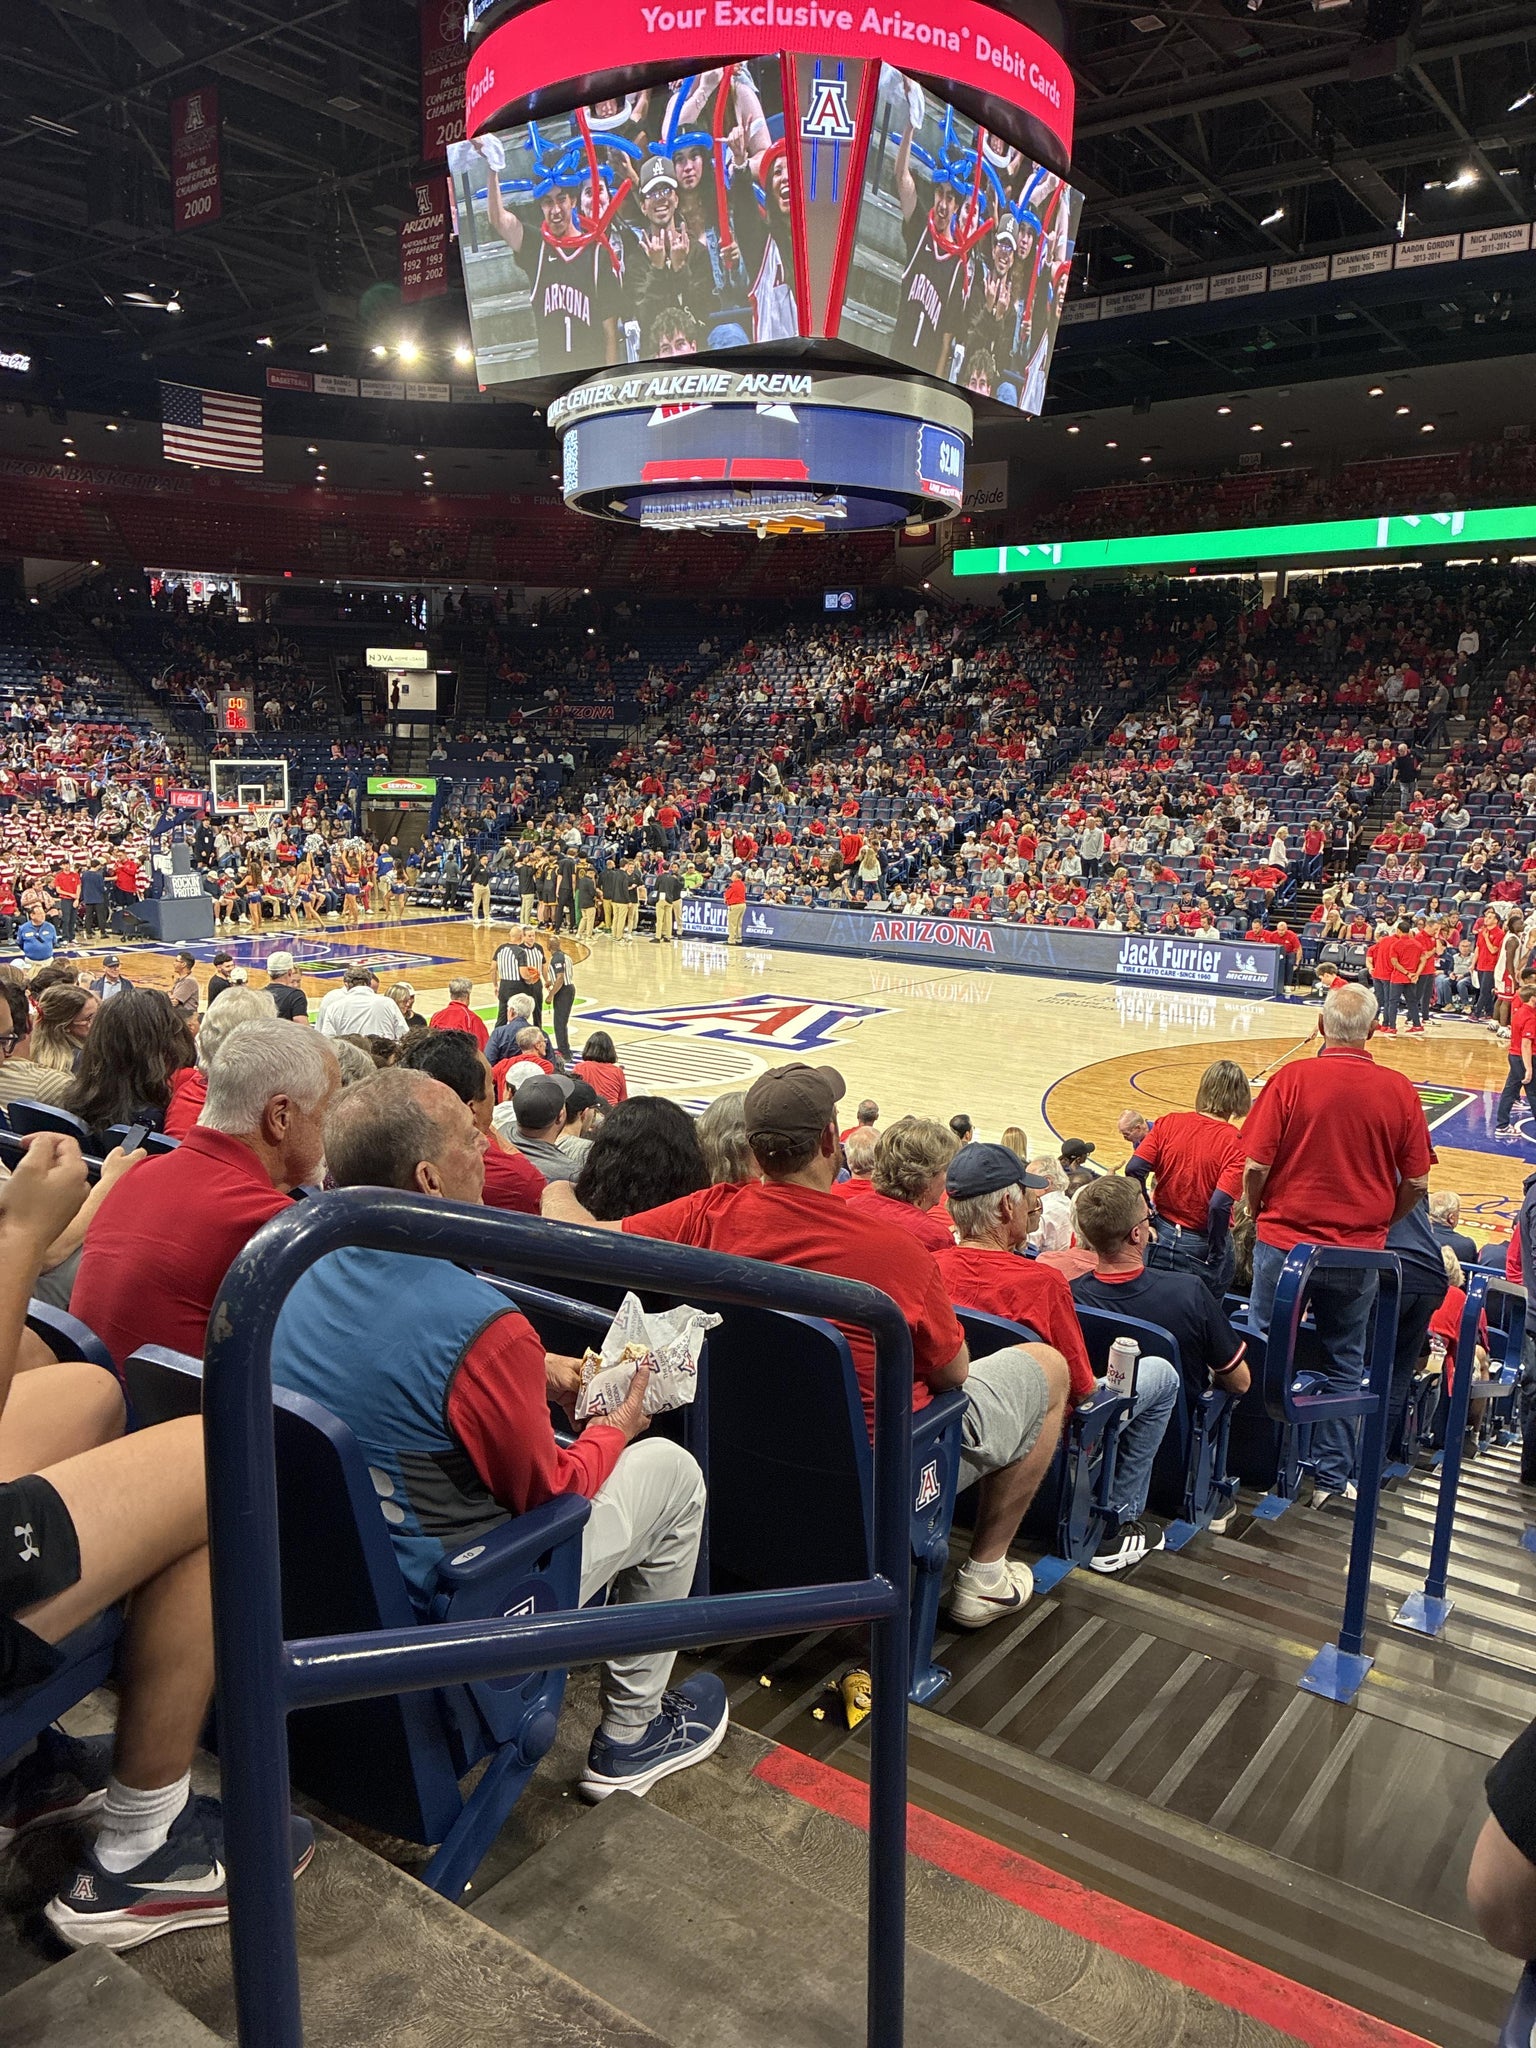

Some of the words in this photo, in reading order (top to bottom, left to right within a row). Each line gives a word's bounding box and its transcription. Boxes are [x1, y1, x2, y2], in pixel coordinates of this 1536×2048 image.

[641, 6, 706, 32] Your
[715, 0, 853, 30] Exclusive
[976, 35, 1025, 81] Debit
[1029, 63, 1061, 109] Cards
[470, 66, 495, 107] Cards
[801, 79, 855, 140] A
[176, 164, 217, 186] CONFERENCE
[176, 175, 217, 198] CHAMPIONS
[184, 195, 212, 219] 2000
[402, 213, 444, 235] ARIZONA
[1471, 234, 1488, 245] NICK
[1489, 229, 1523, 241] JOHNSON
[1401, 244, 1425, 255] AARON
[1427, 239, 1455, 251] GORDON
[1480, 241, 1511, 253] 2011-2014
[403, 258, 422, 272] 1992
[426, 253, 443, 266] 1993
[1337, 254, 1371, 266] CHANNING
[1372, 249, 1389, 260] FRYE
[1412, 252, 1442, 263] 2013-2014
[425, 267, 444, 281] 2002
[1237, 271, 1264, 284] BAYLESS
[1273, 267, 1298, 278] STANLEY
[1299, 261, 1328, 273] JOHNSON
[544, 283, 590, 327] ARIZONA
[564, 316, 572, 352] 1
[567, 384, 615, 411] CENTER
[617, 379, 645, 400] AT
[645, 374, 733, 396] ALKEME
[735, 372, 813, 394] ARENA
[387, 782, 417, 790] SERVPRO
[171, 877, 200, 889] ROCKIN
[174, 886, 201, 898] PROTEIN
[682, 900, 701, 924] ack
[870, 920, 996, 954] ARIZONA
[1119, 937, 1159, 967] Jack
[1162, 940, 1222, 973] Furrier
[1122, 965, 1136, 974] TIRE
[1143, 967, 1160, 976] AUTO
[1160, 969, 1177, 978] CARE
[1225, 972, 1269, 983] MICHELIN
